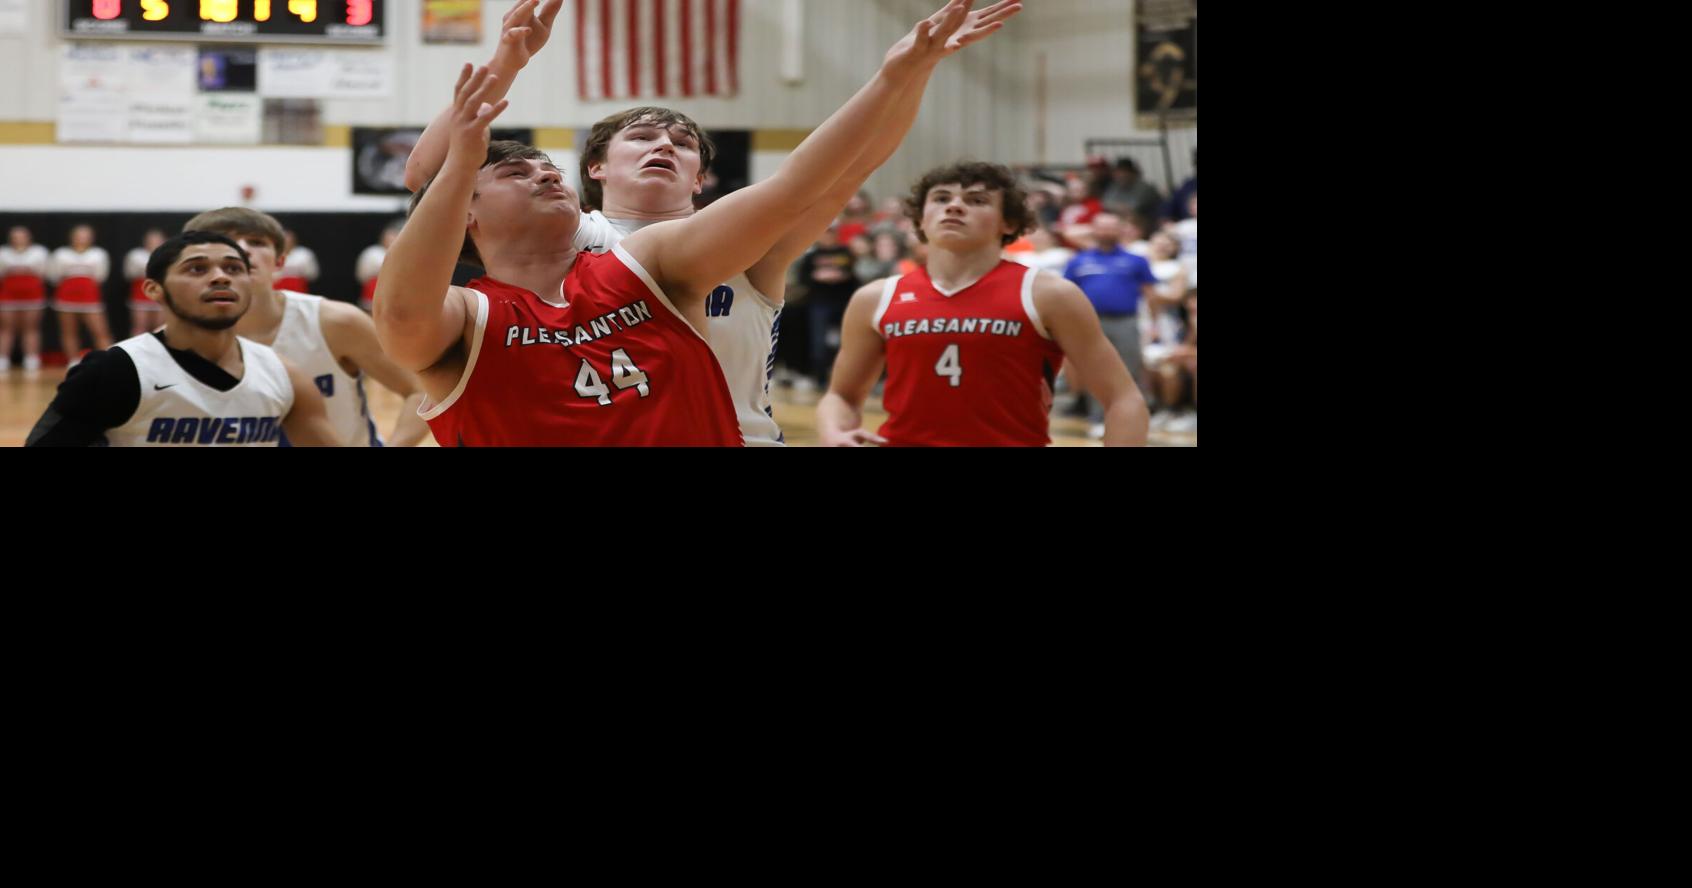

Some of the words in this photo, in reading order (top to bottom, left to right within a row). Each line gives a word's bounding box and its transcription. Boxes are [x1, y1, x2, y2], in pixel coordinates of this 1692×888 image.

[505, 299, 653, 347] PLESANTON
[884, 317, 1023, 338] PLEASANTON
[573, 347, 651, 406] 44
[934, 343, 963, 388] 4
